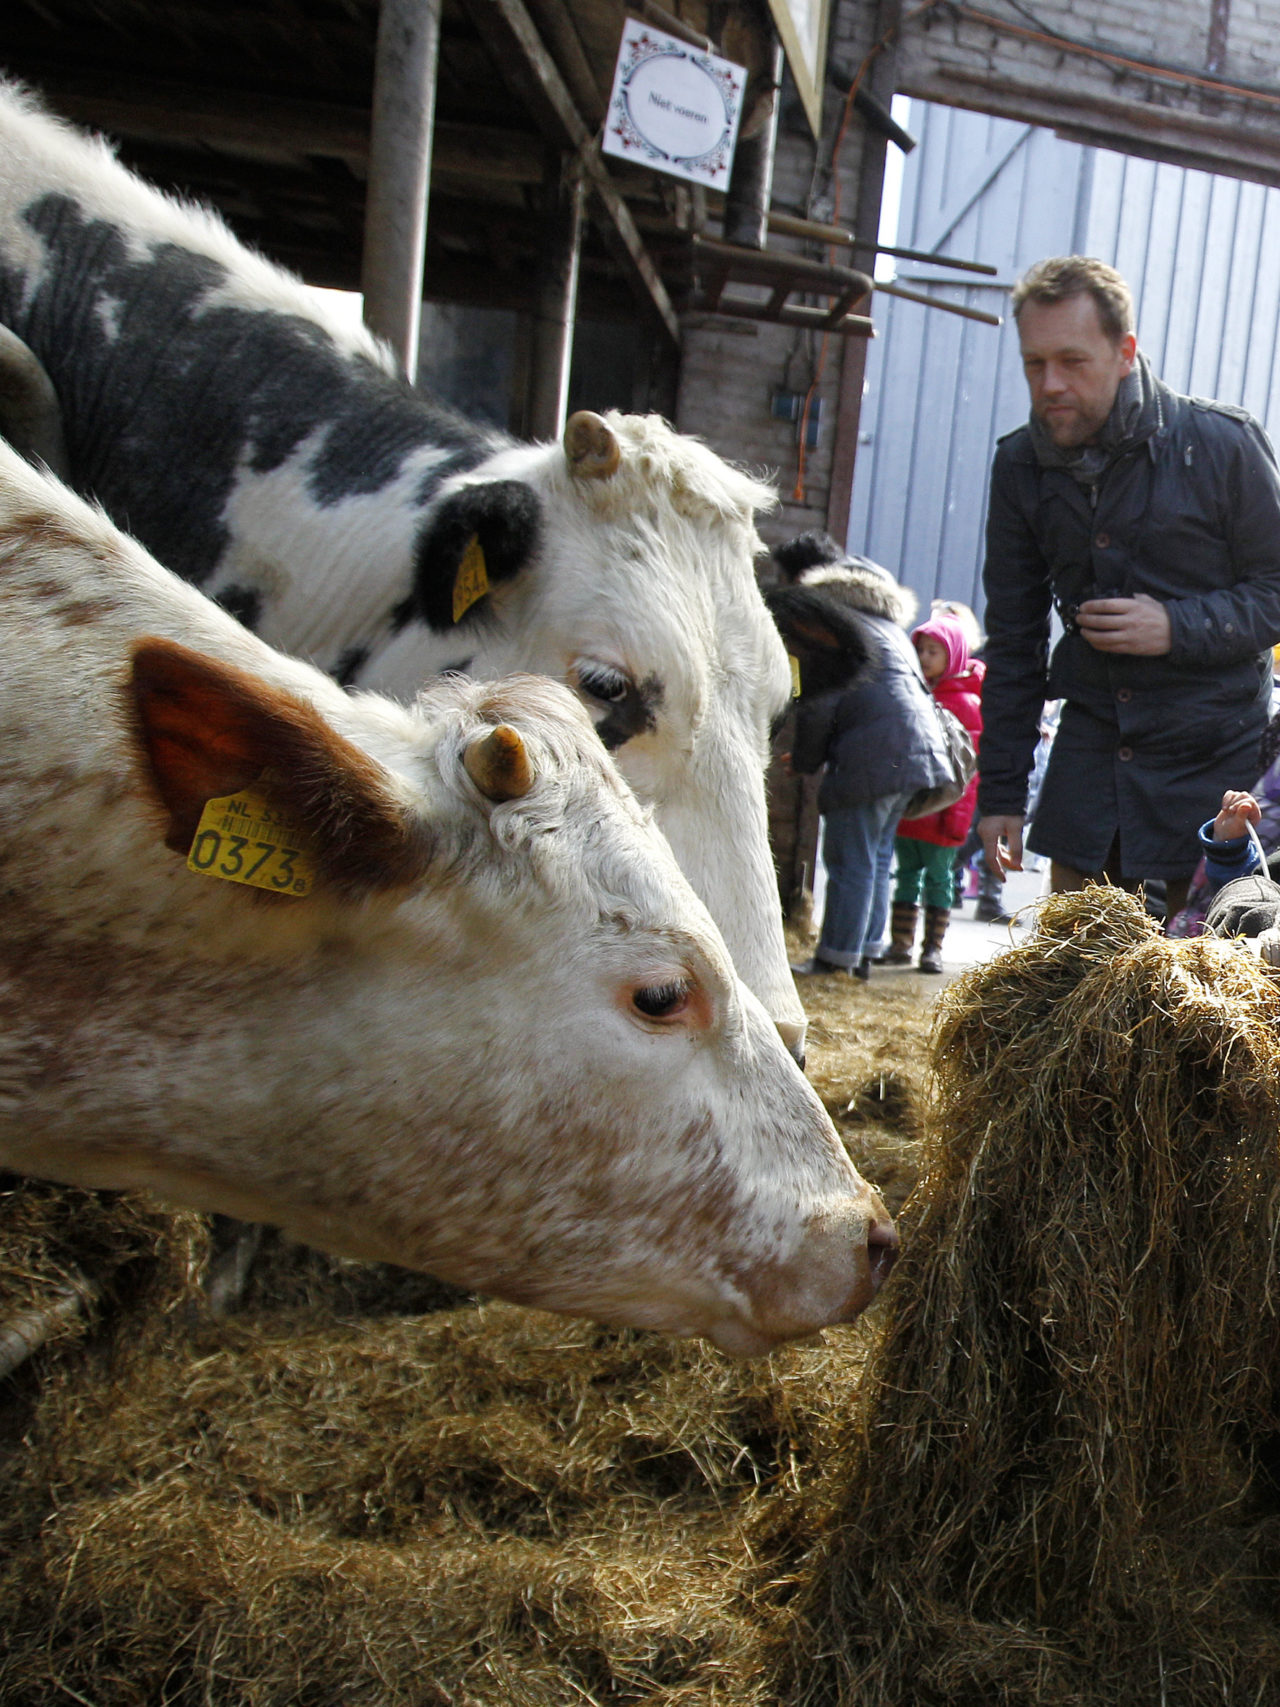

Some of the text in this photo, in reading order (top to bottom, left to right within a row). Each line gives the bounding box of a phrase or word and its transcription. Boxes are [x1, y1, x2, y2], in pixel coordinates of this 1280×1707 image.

[648, 90, 707, 124] Niet voeren
[227, 800, 251, 818] NL
[193, 829, 300, 888] 0373
